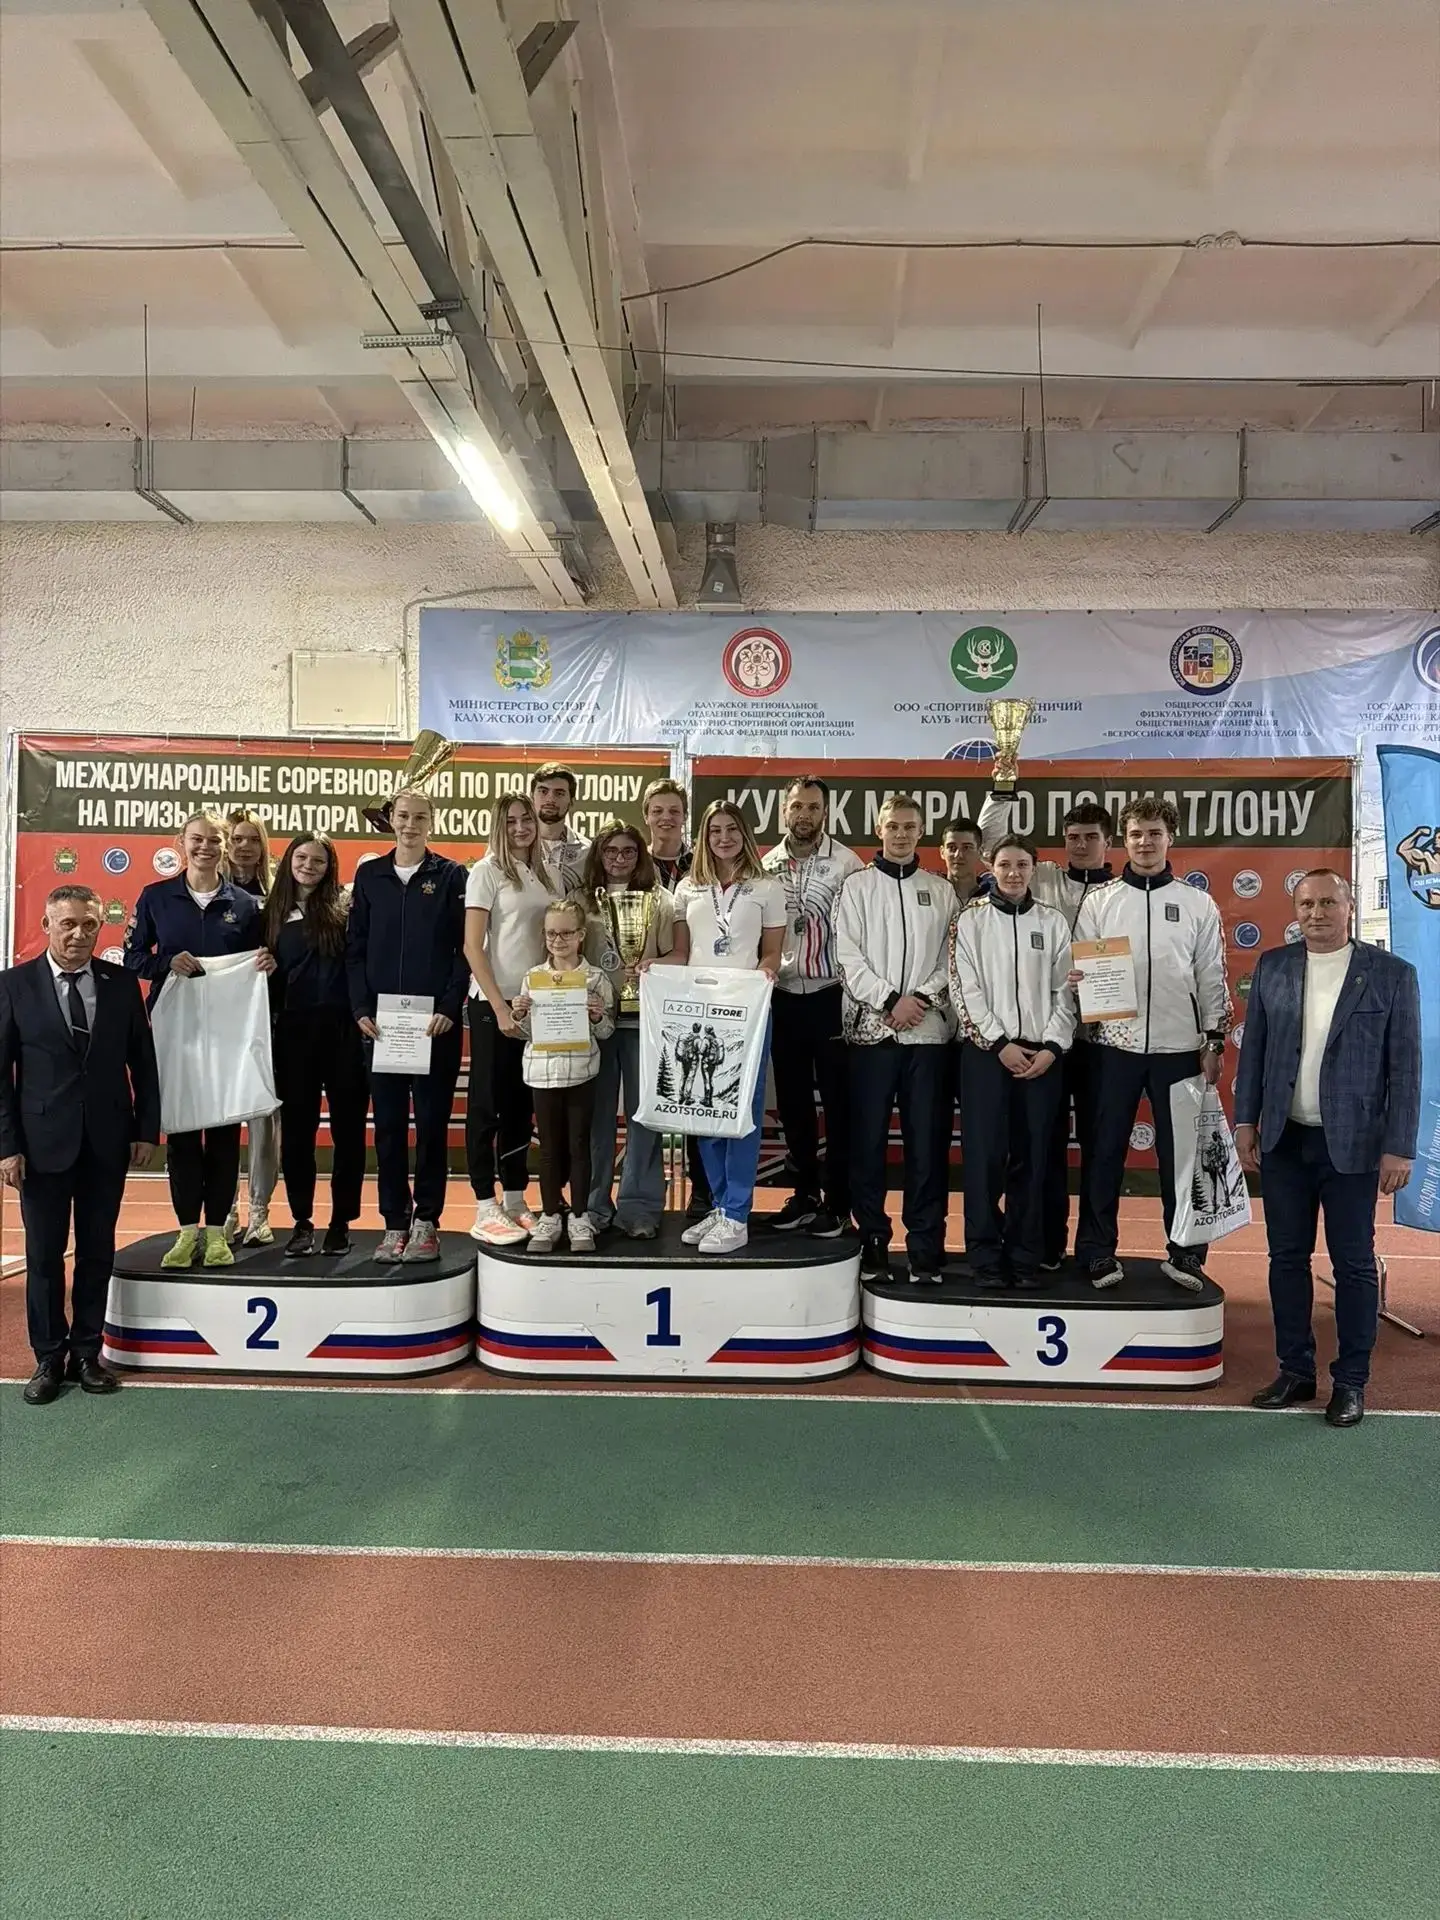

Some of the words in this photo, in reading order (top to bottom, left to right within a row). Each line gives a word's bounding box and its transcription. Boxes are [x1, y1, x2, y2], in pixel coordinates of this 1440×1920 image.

[449, 700, 549, 711] МИНИСТЕРСТВО
[695, 701, 749, 710] КАЛУЖСКОЕ
[751, 701, 819, 710] РЕГИОНАЛЬНОЕ
[893, 703, 920, 712] ООО
[1165, 701, 1252, 710] ОБЩЕРОССИЙСКАЯ
[454, 713, 534, 724] КАЛУЖСКОЙ
[687, 710, 739, 719] ОТДЕЛЕНИЕ
[740, 710, 825, 719] ОБЩЕРОССИЙСКОЙ
[921, 715, 951, 724] КЛУБ
[790, 720, 855, 728] ОРГАНИЗАЦИИ
[1136, 719, 1210, 728] ОБЩЕСТВЕННАЯ
[736, 728, 789, 737] ФЕДЕРАЦИЯ
[790, 728, 855, 737] ПОЛИАТЛОНА»
[1102, 729, 1184, 738] «ВСЕРОССИЙСКАЯ
[1186, 729, 1241, 738] ФЕДЕРАЦИЯ
[55, 760, 272, 795] МЕЖДУНАРОДНЫЕ
[276, 766, 454, 798] СОРЕВНОВАИЯ
[460, 771, 489, 799] ПО
[495, 772, 643, 802] ПОТЛОНУ
[78, 799, 108, 827] НА
[114, 800, 195, 829] ПРИЗЫ
[864, 790, 971, 836] МРА
[1047, 789, 1315, 837] ПЛТЛОНУ
[667, 1003, 701, 1014] AZOT
[711, 1007, 743, 1018] STORE
[654, 1103, 738, 1120] AZOTSTORE.RU
[1194, 1202, 1245, 1227] AZOTTORE.RU
[646, 1287, 681, 1346] 1
[246, 1297, 279, 1350] 2
[1036, 1316, 1069, 1367] 3
